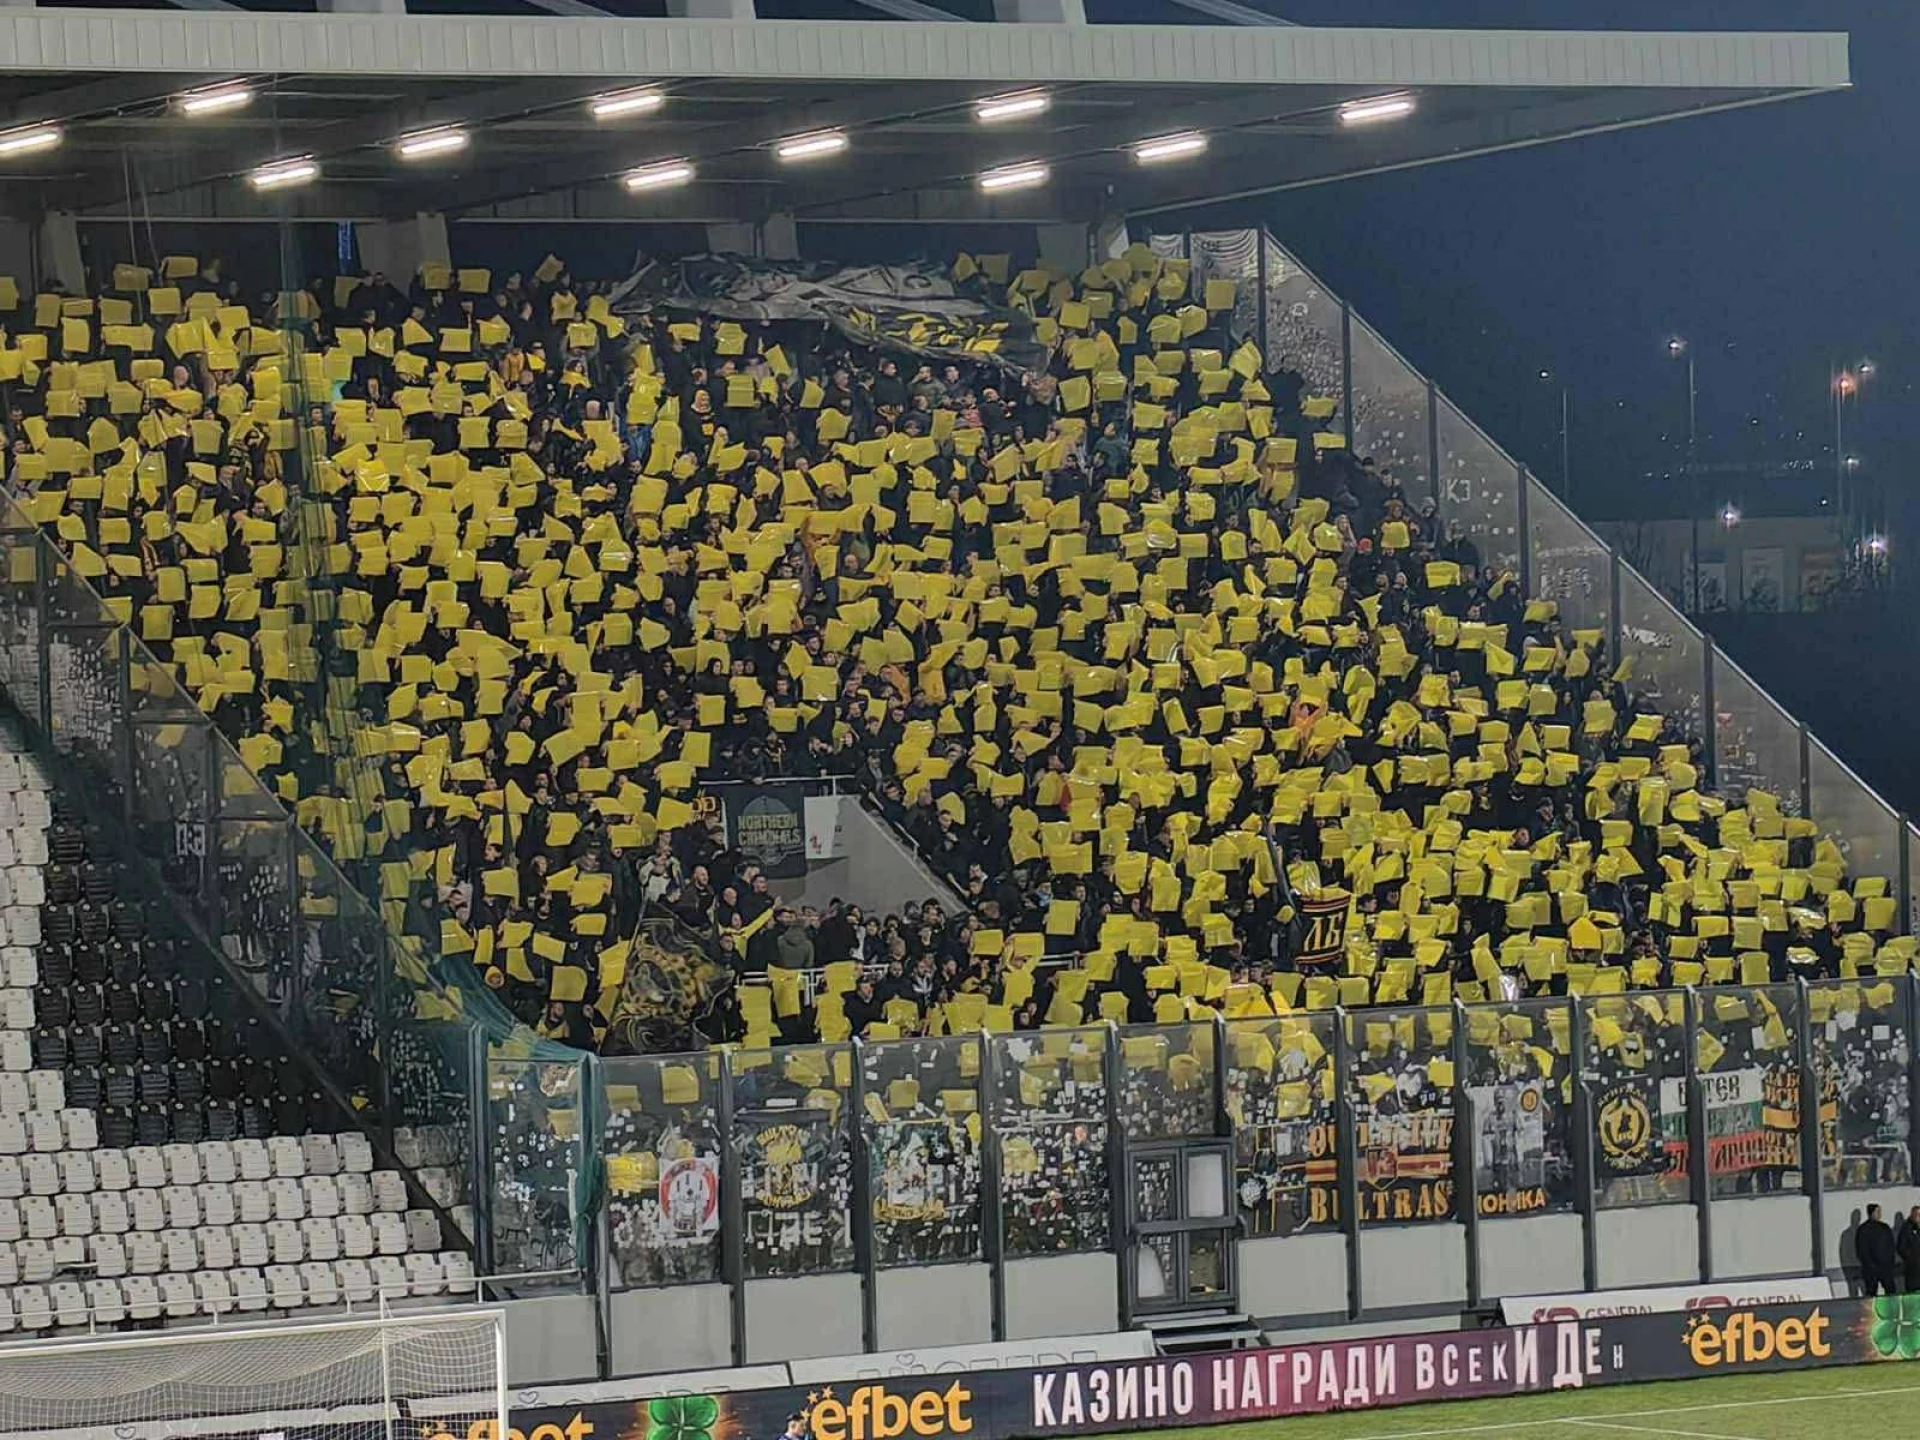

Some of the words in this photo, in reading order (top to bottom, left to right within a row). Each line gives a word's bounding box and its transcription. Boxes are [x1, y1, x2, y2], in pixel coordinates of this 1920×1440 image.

[1690, 1306, 1831, 1366] efbet
[1033, 1362, 1193, 1427] КАЗИНО
[1212, 1344, 1396, 1411] НАГРАДИ
[1415, 1328, 1539, 1391] ВСЕКИ
[810, 1380, 973, 1440] efbet
